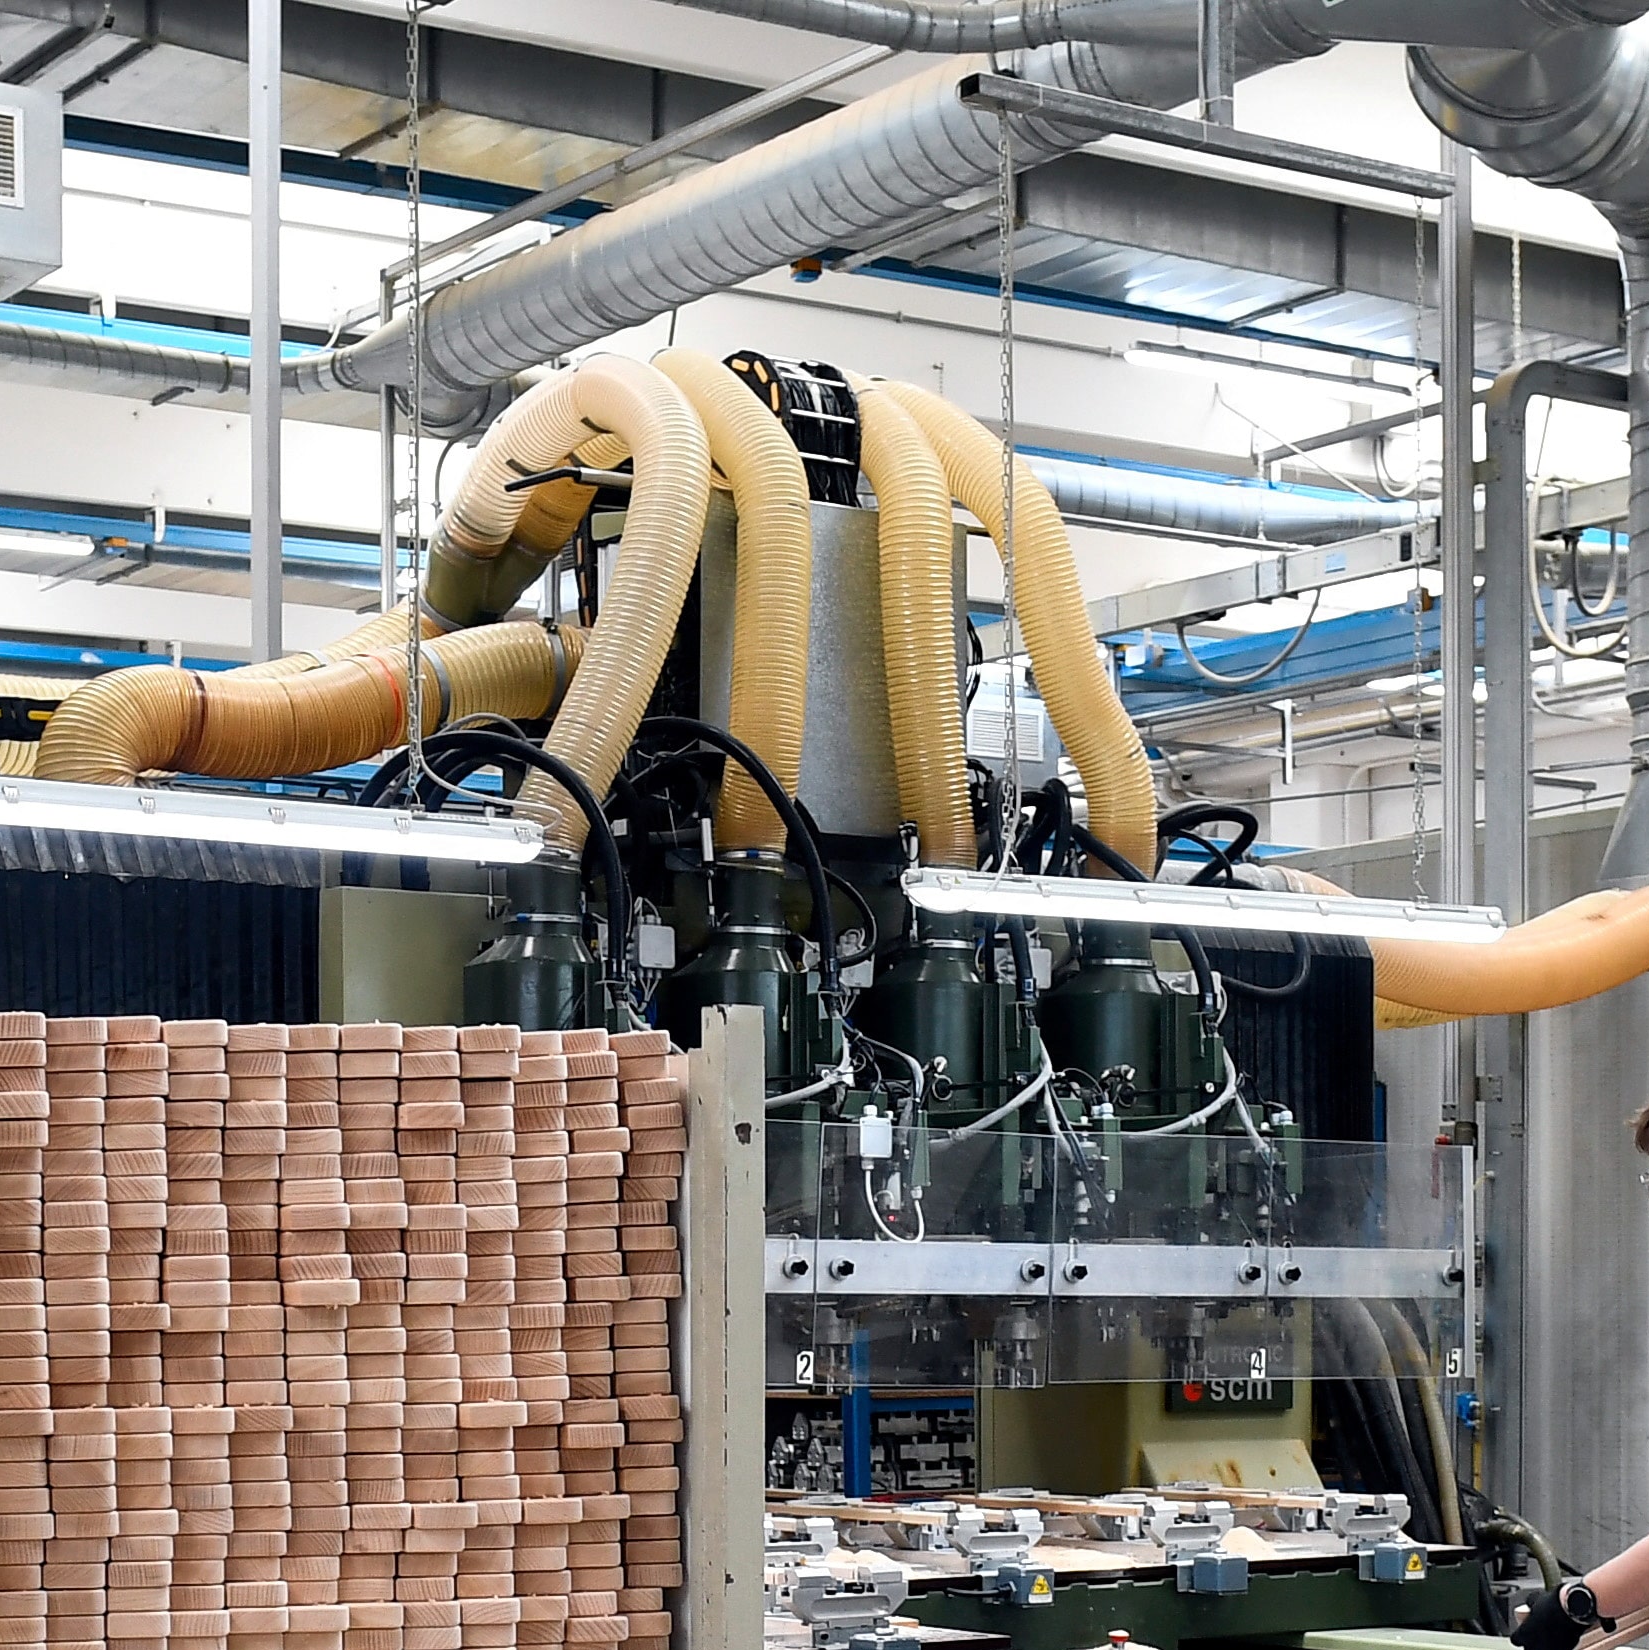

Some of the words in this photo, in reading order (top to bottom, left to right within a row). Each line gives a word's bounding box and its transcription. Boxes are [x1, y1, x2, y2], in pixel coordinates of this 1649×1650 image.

[798, 1354, 811, 1381] 2
[1251, 1351, 1264, 1376] 4
[1448, 1350, 1458, 1375] 5
[1210, 1379, 1273, 1402] scm
